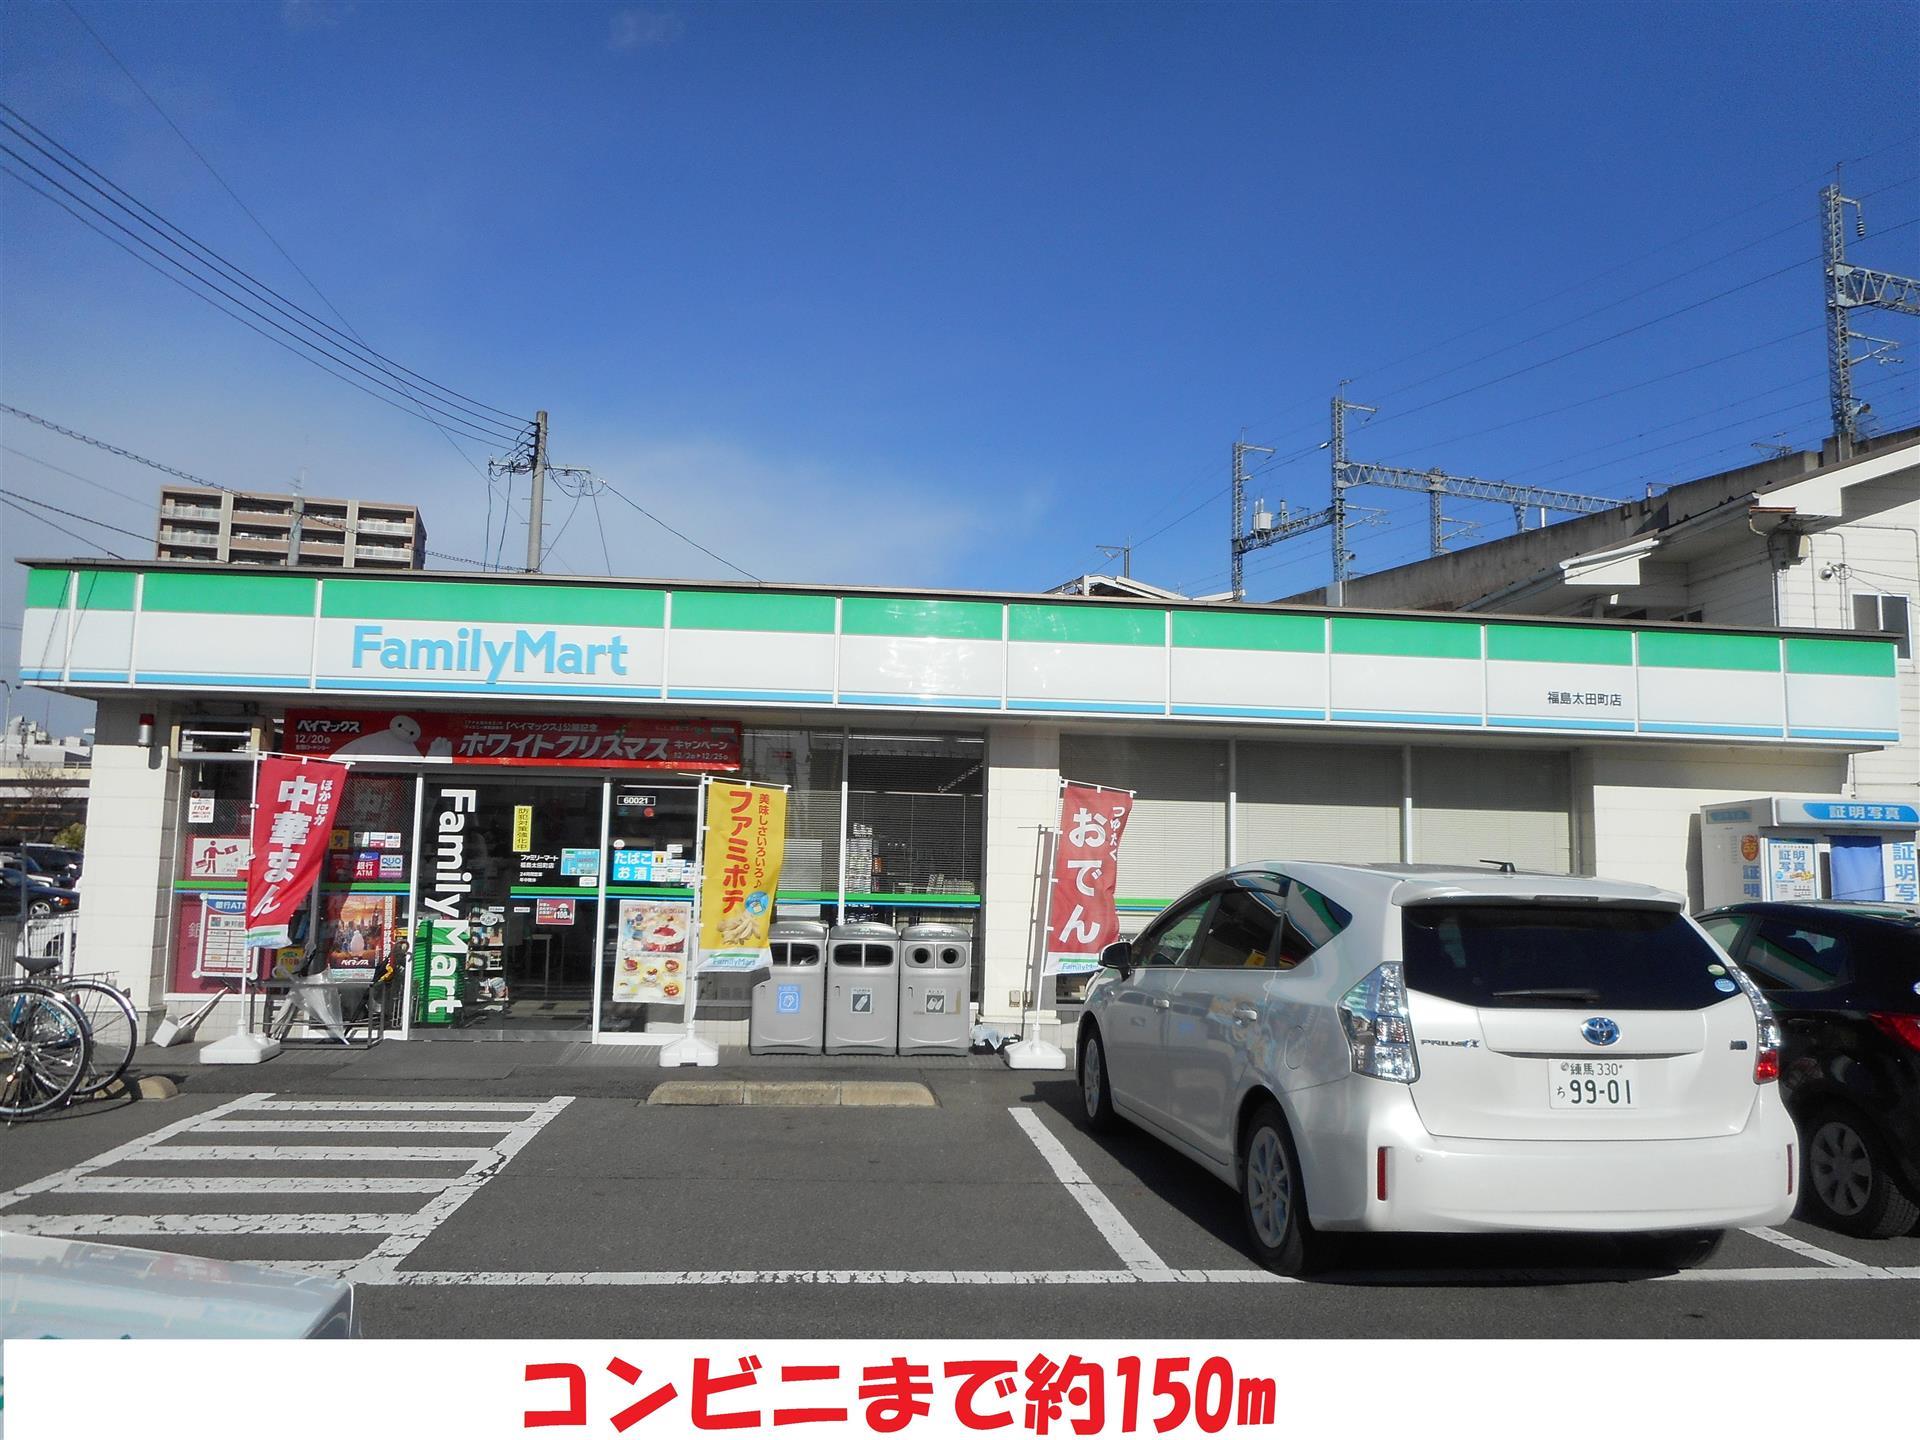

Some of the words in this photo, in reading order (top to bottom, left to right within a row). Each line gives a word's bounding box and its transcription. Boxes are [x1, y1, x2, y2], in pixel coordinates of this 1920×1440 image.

[352, 624, 629, 684] FamilyMart
[1547, 691, 1622, 706] 福島太田町店
[297, 720, 360, 733] ベイマックス
[674, 740, 728, 750] キャンペーン
[313, 779, 333, 826] ほかほか
[1829, 805, 1900, 820] 証明写真
[250, 775, 318, 918] 中華まん
[722, 790, 753, 914] ファミポテ
[356, 861, 374, 870] 銀行
[381, 857, 402, 865] QUO
[614, 852, 651, 865] たばこ
[1058, 807, 1107, 944] おでん
[424, 788, 477, 1014] FamilyMart
[1570, 1062, 1594, 1076] 練馬
[1597, 1062, 1618, 1076] 330
[1557, 1085, 1566, 1099] ち
[1570, 1079, 1631, 1104] 99-01
